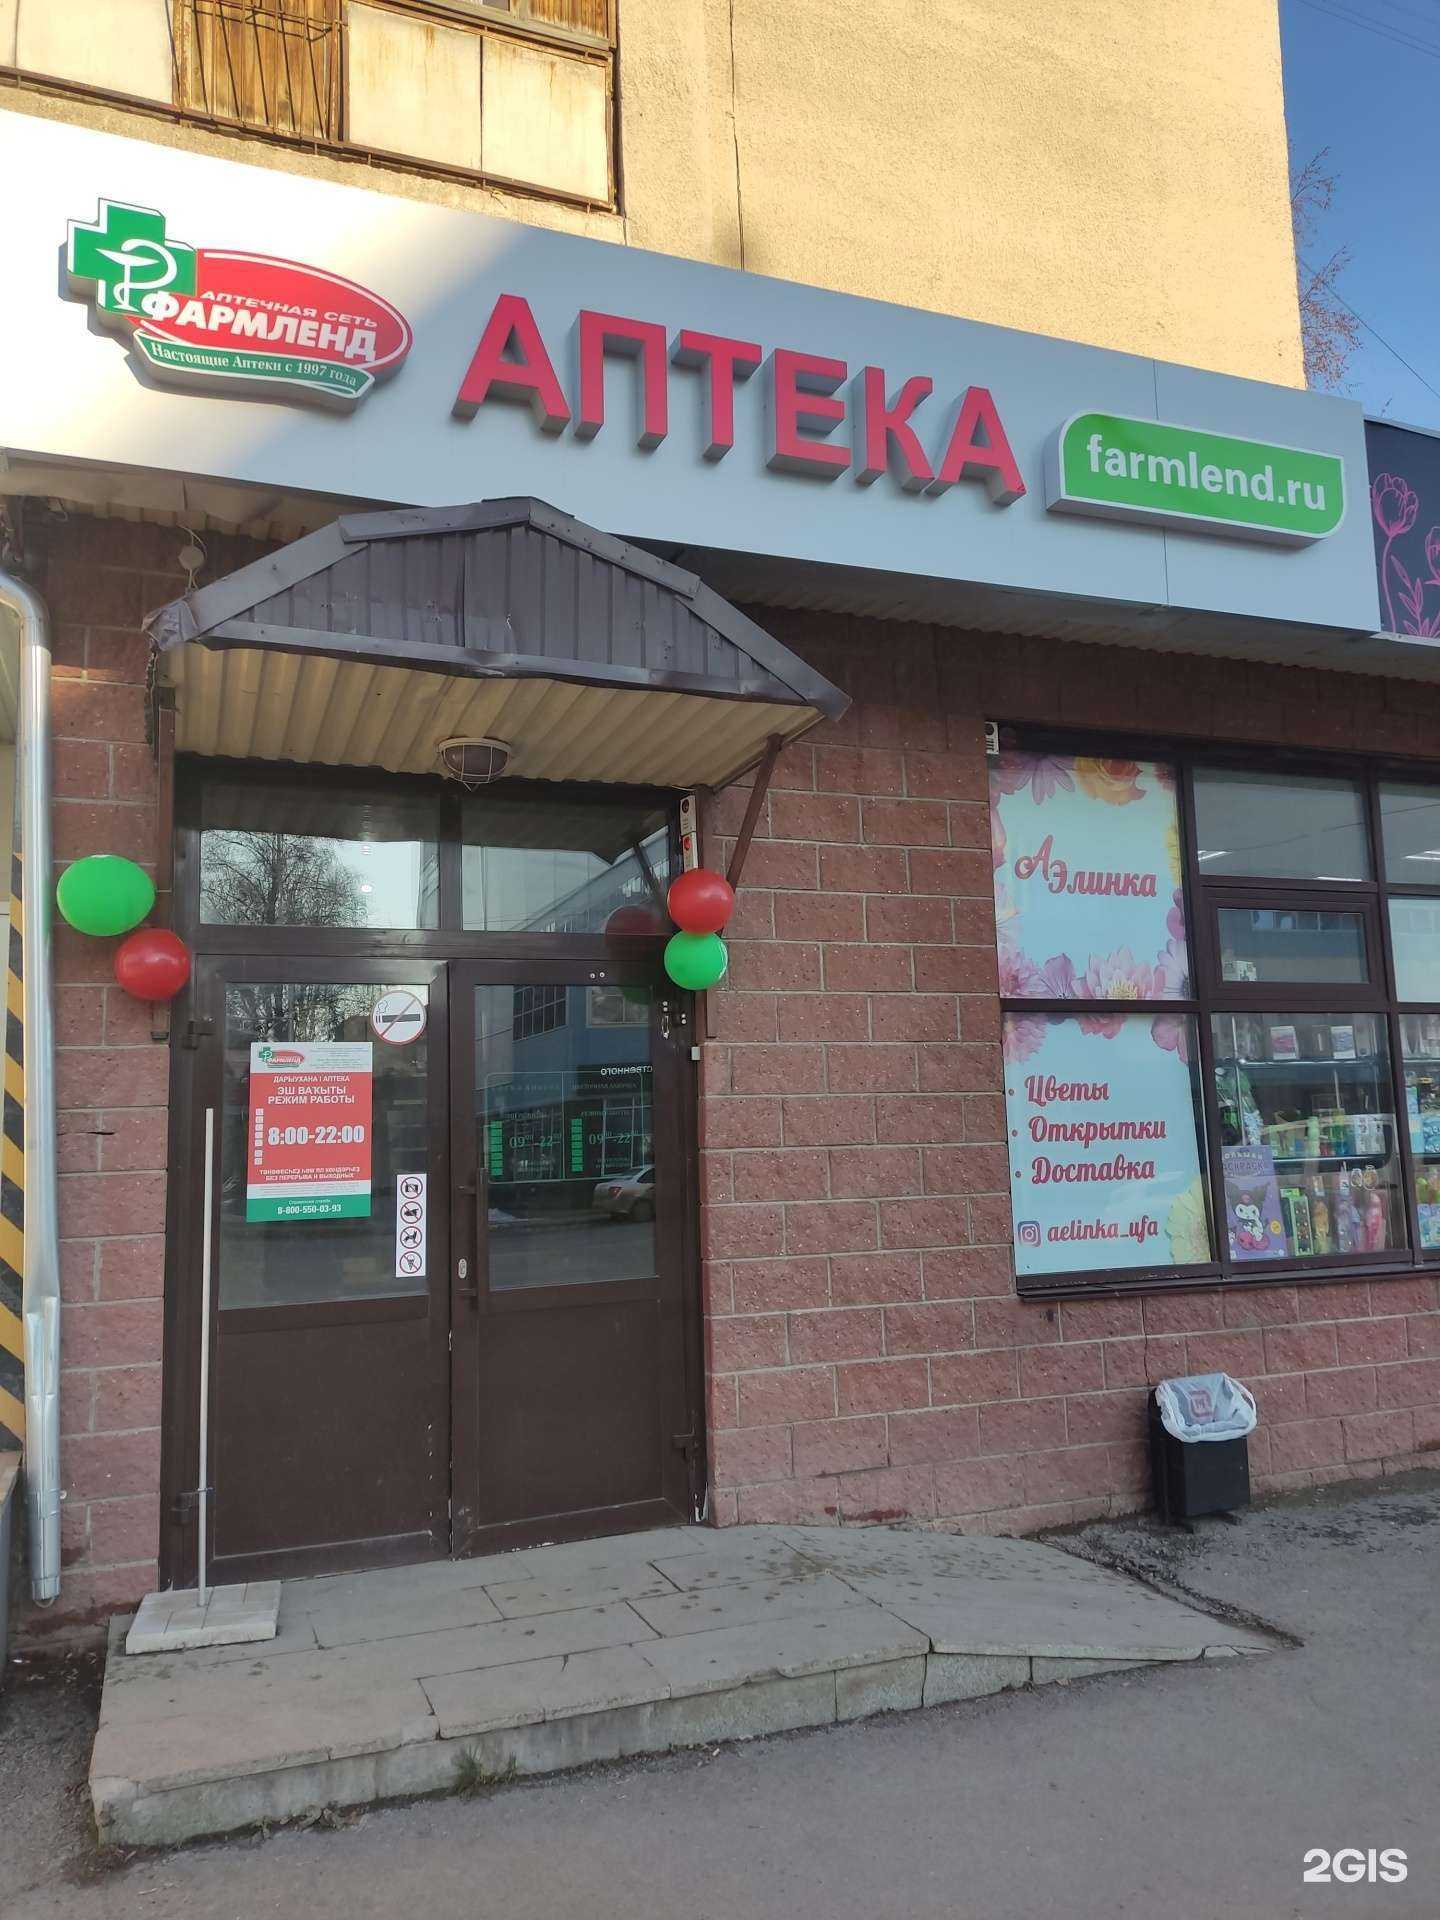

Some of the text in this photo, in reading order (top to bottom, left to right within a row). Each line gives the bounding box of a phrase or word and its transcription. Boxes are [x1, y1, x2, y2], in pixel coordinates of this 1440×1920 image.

[200, 290, 378, 328] АПТЕЧНАЯ СЕТЬ
[141, 290, 377, 362] ФАРМЛЕНД
[151, 341, 358, 386] Настоящие Аптеки с 1997 года
[452, 293, 1026, 507] АПТЕКА
[1086, 434, 1327, 511] farmlend.ru
[268, 1095, 355, 1105] РЕЖИМ РАБОТЫ
[277, 1086, 295, 1095] ЭШ
[1024, 1075, 1110, 1107] Цветы
[268, 1125, 365, 1146] 8:00-22:00
[1029, 1115, 1166, 1149] Открытки
[1031, 1153, 1156, 1185] Доставка
[1047, 1214, 1159, 1243] aelinka_ufa
